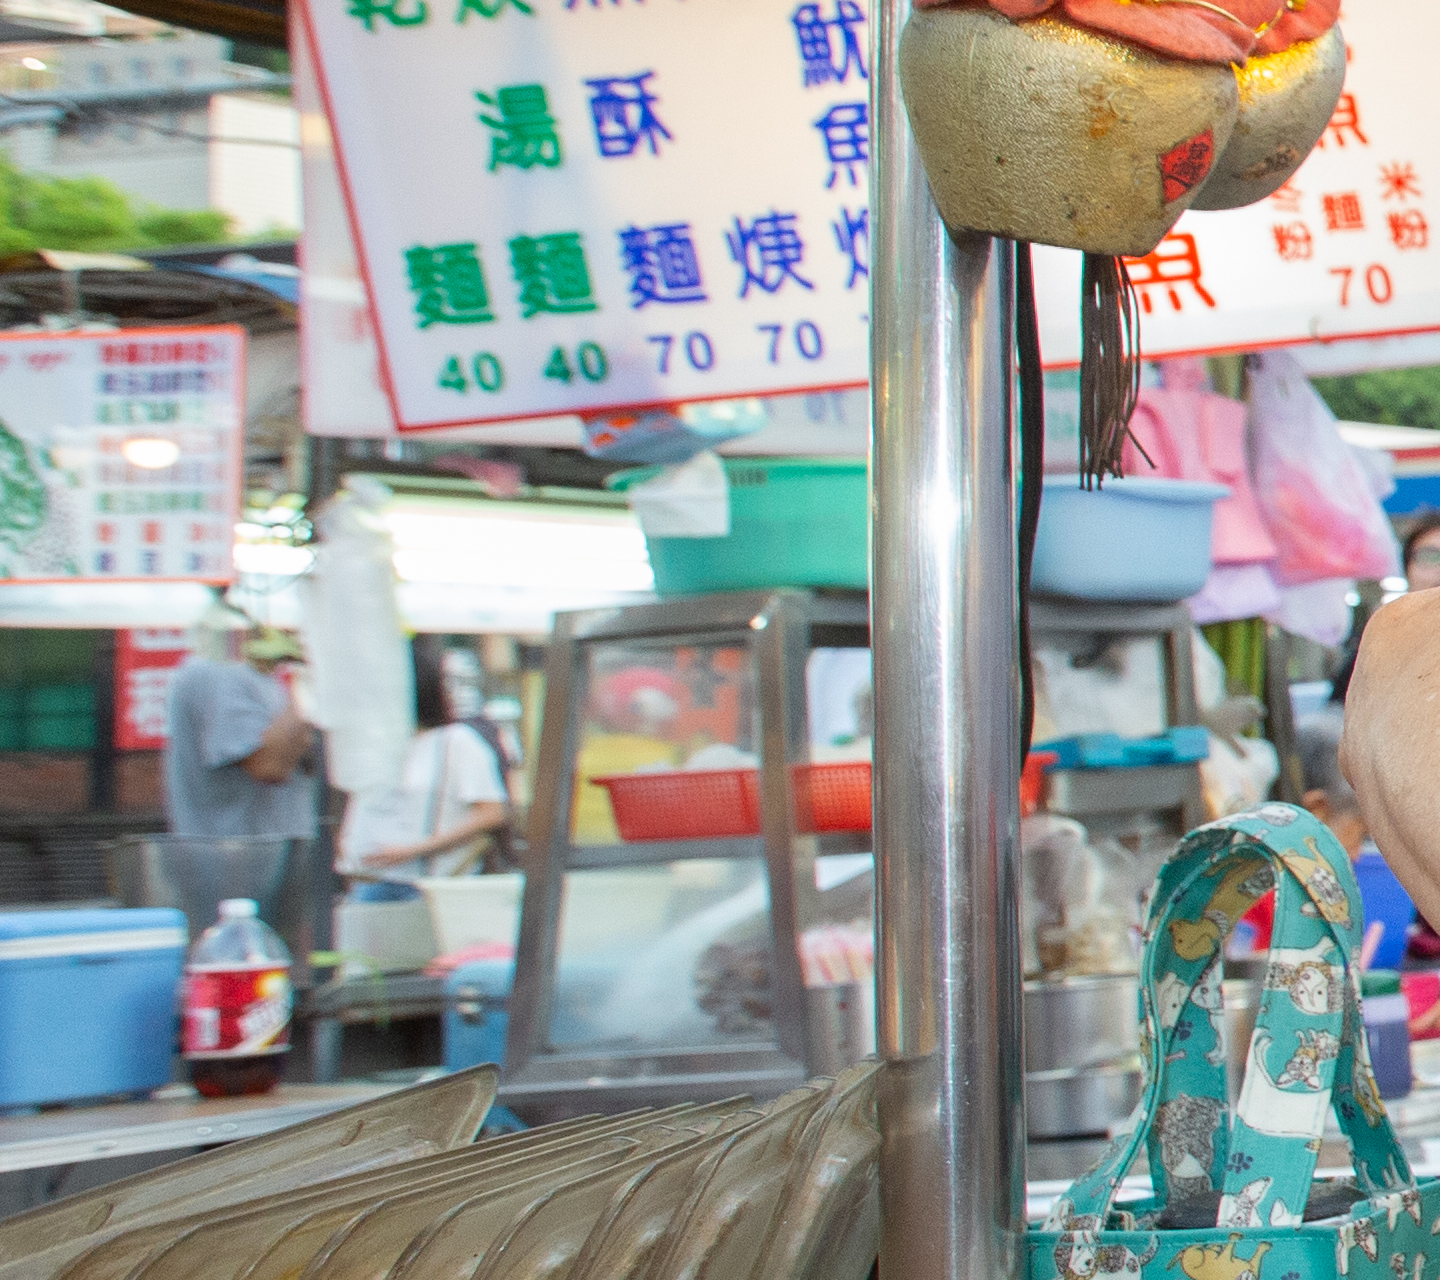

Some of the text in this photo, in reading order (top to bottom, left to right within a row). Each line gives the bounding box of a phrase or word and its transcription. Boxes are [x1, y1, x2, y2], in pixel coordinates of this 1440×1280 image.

[1379, 158, 1430, 251] 米粉
[1328, 262, 1395, 307] 70
[542, 342, 609, 387] 40
[649, 331, 717, 375] 70
[757, 320, 825, 366] 70
[437, 352, 503, 396] 40
